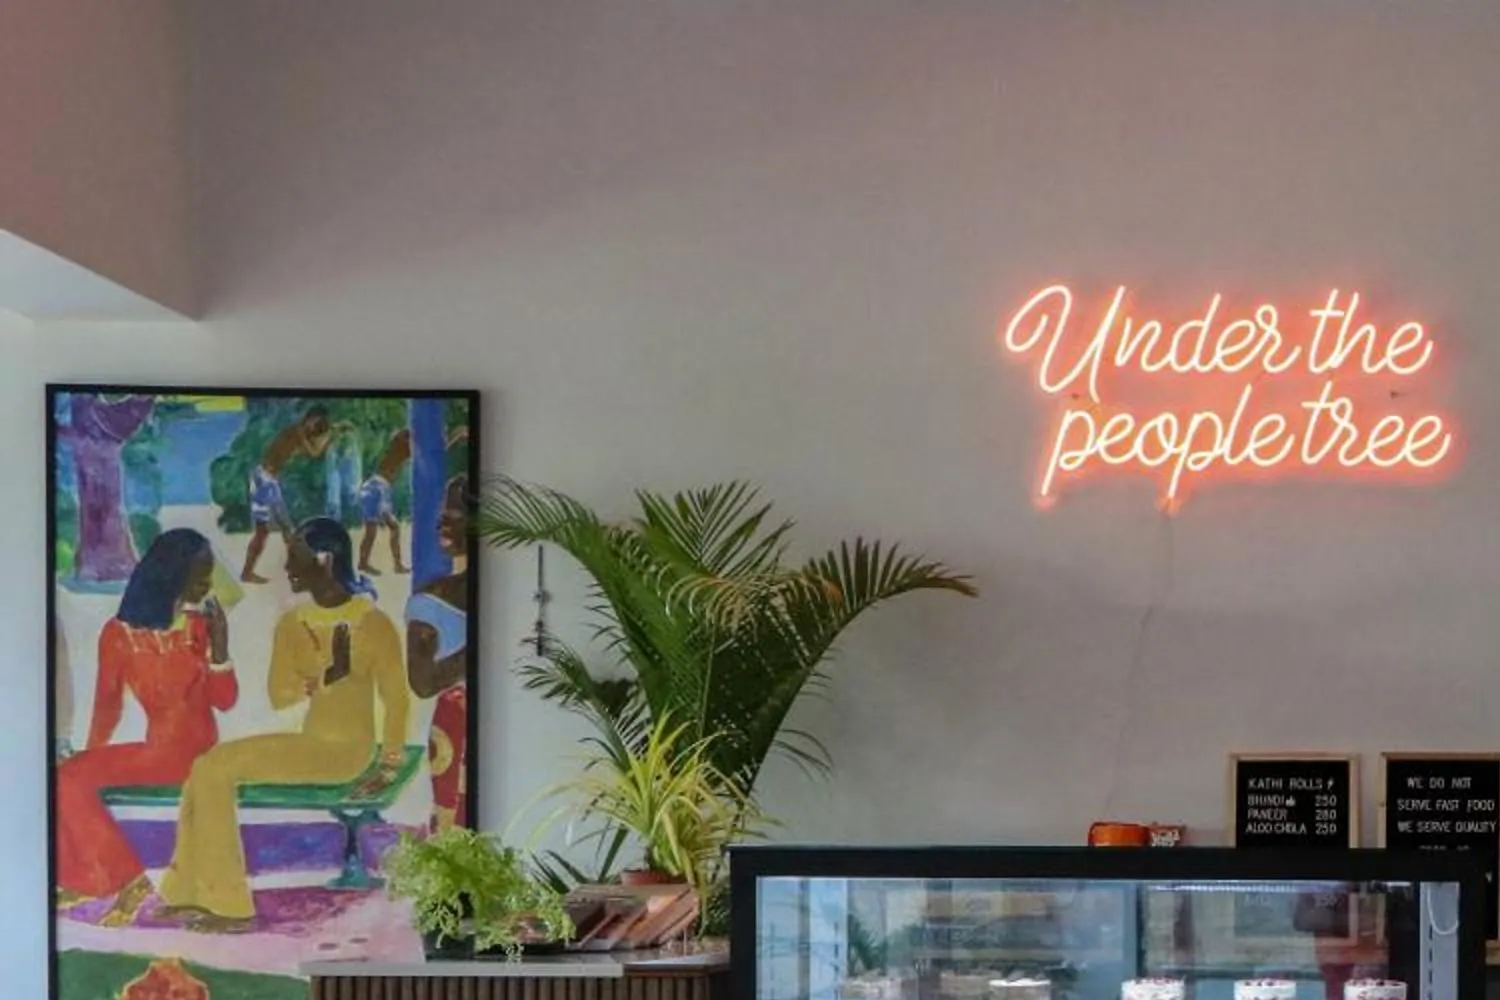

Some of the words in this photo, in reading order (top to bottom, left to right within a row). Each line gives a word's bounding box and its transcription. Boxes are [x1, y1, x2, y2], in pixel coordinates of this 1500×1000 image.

[1004, 284, 1301, 404] Under
[1309, 288, 1433, 374] the
[1040, 383, 1296, 498] people
[1301, 381, 1451, 467] tree
[1248, 777, 1283, 790] KATHI
[1289, 777, 1323, 790] ROLLS
[1407, 776, 1424, 789] WE
[1429, 776, 1445, 789] DO
[1451, 776, 1473, 789] NOT
[1396, 799, 1433, 811] SERVE
[1435, 799, 1461, 812] FAST
[1466, 799, 1496, 813] FOOD
[1247, 808, 1289, 821] PANEER
[1245, 822, 1273, 835] ALOO
[1397, 820, 1415, 833] WE
[1416, 820, 1451, 833] SERVE
[1455, 820, 1498, 833] QUALITY
